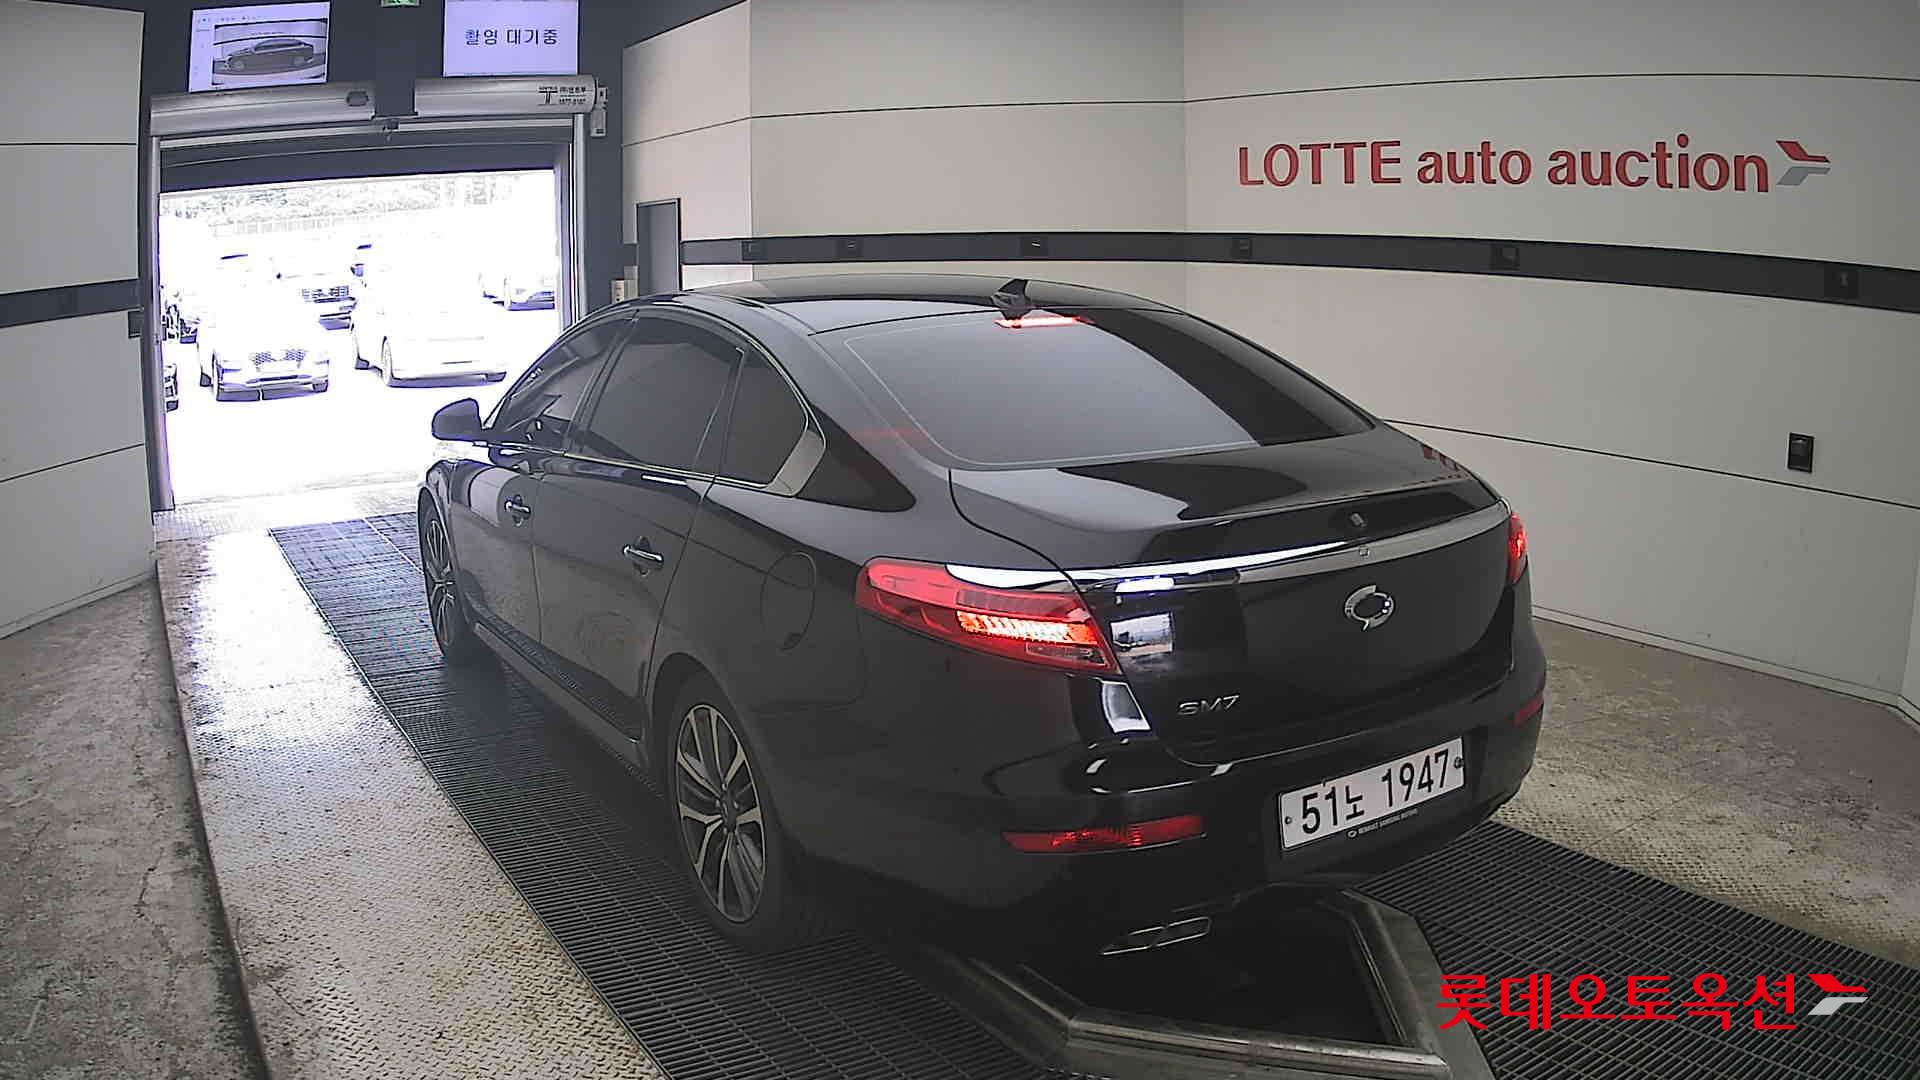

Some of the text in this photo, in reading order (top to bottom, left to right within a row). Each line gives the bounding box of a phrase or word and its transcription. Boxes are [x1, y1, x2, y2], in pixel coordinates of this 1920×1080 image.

[506, 29, 558, 46] 대기중
[1239, 133, 1770, 193] LOTTE auto auction
[1177, 694, 1241, 716] SM7
[1301, 785, 1366, 836] 51노
[1380, 748, 1450, 809] 1947
